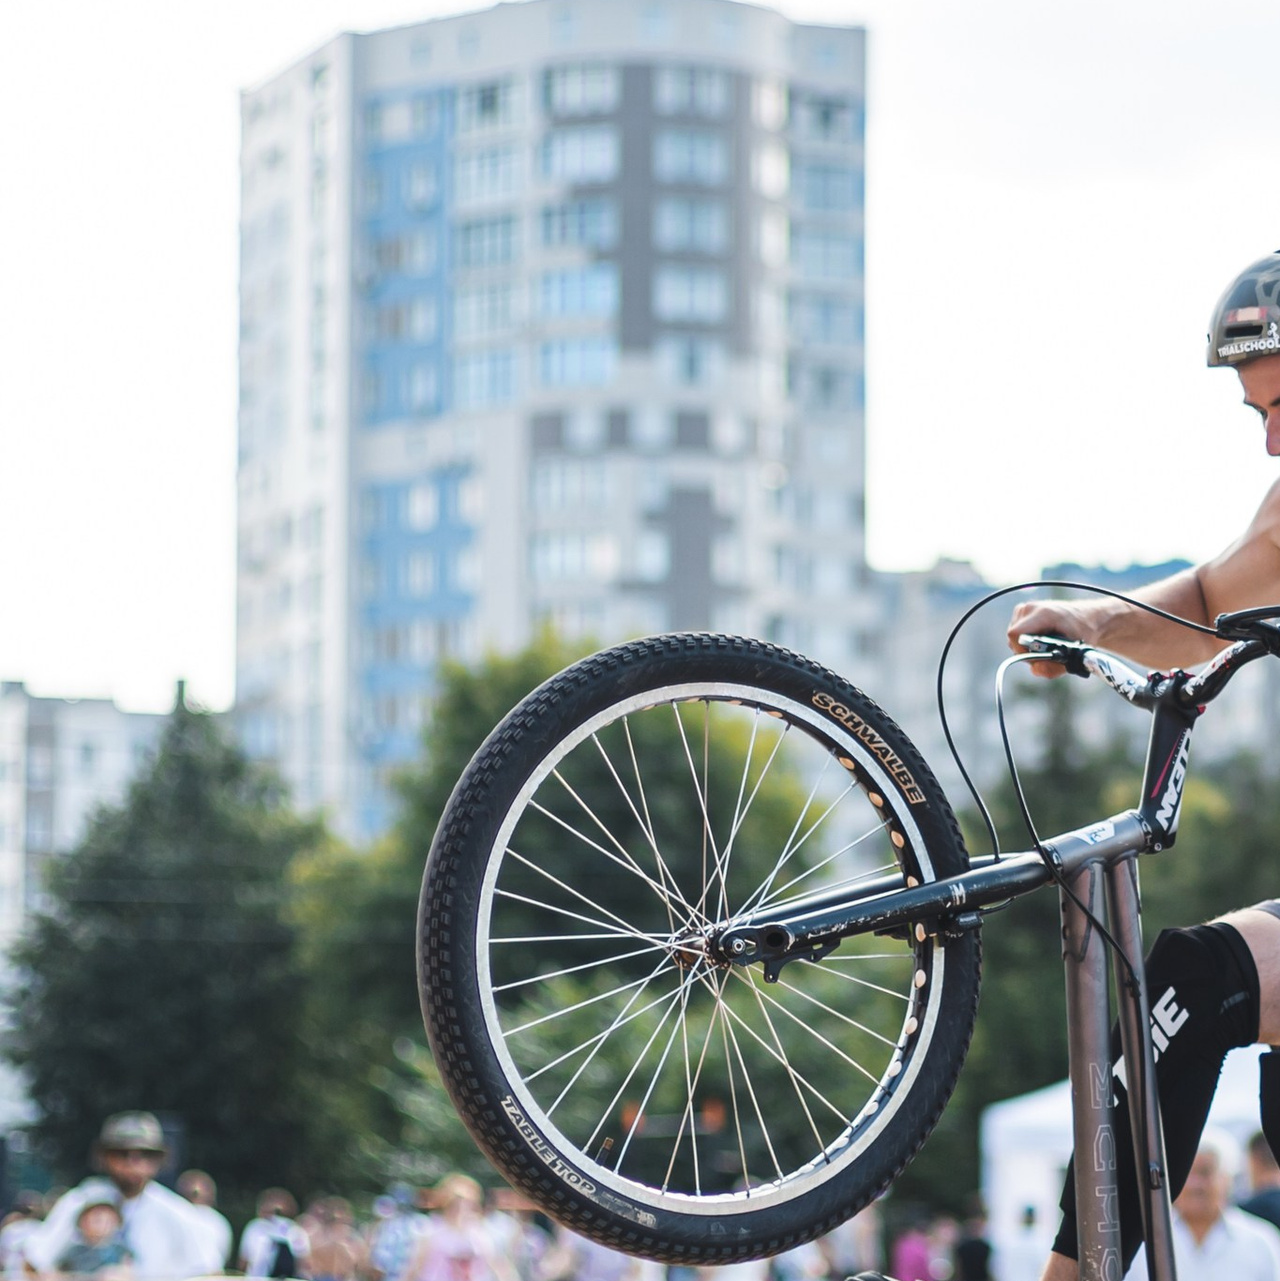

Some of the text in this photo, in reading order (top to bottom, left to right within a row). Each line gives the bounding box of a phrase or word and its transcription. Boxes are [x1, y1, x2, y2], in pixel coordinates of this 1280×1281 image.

[811, 692, 926, 805] SCHWALBE
[501, 1095, 597, 1197] TABLE TOP
